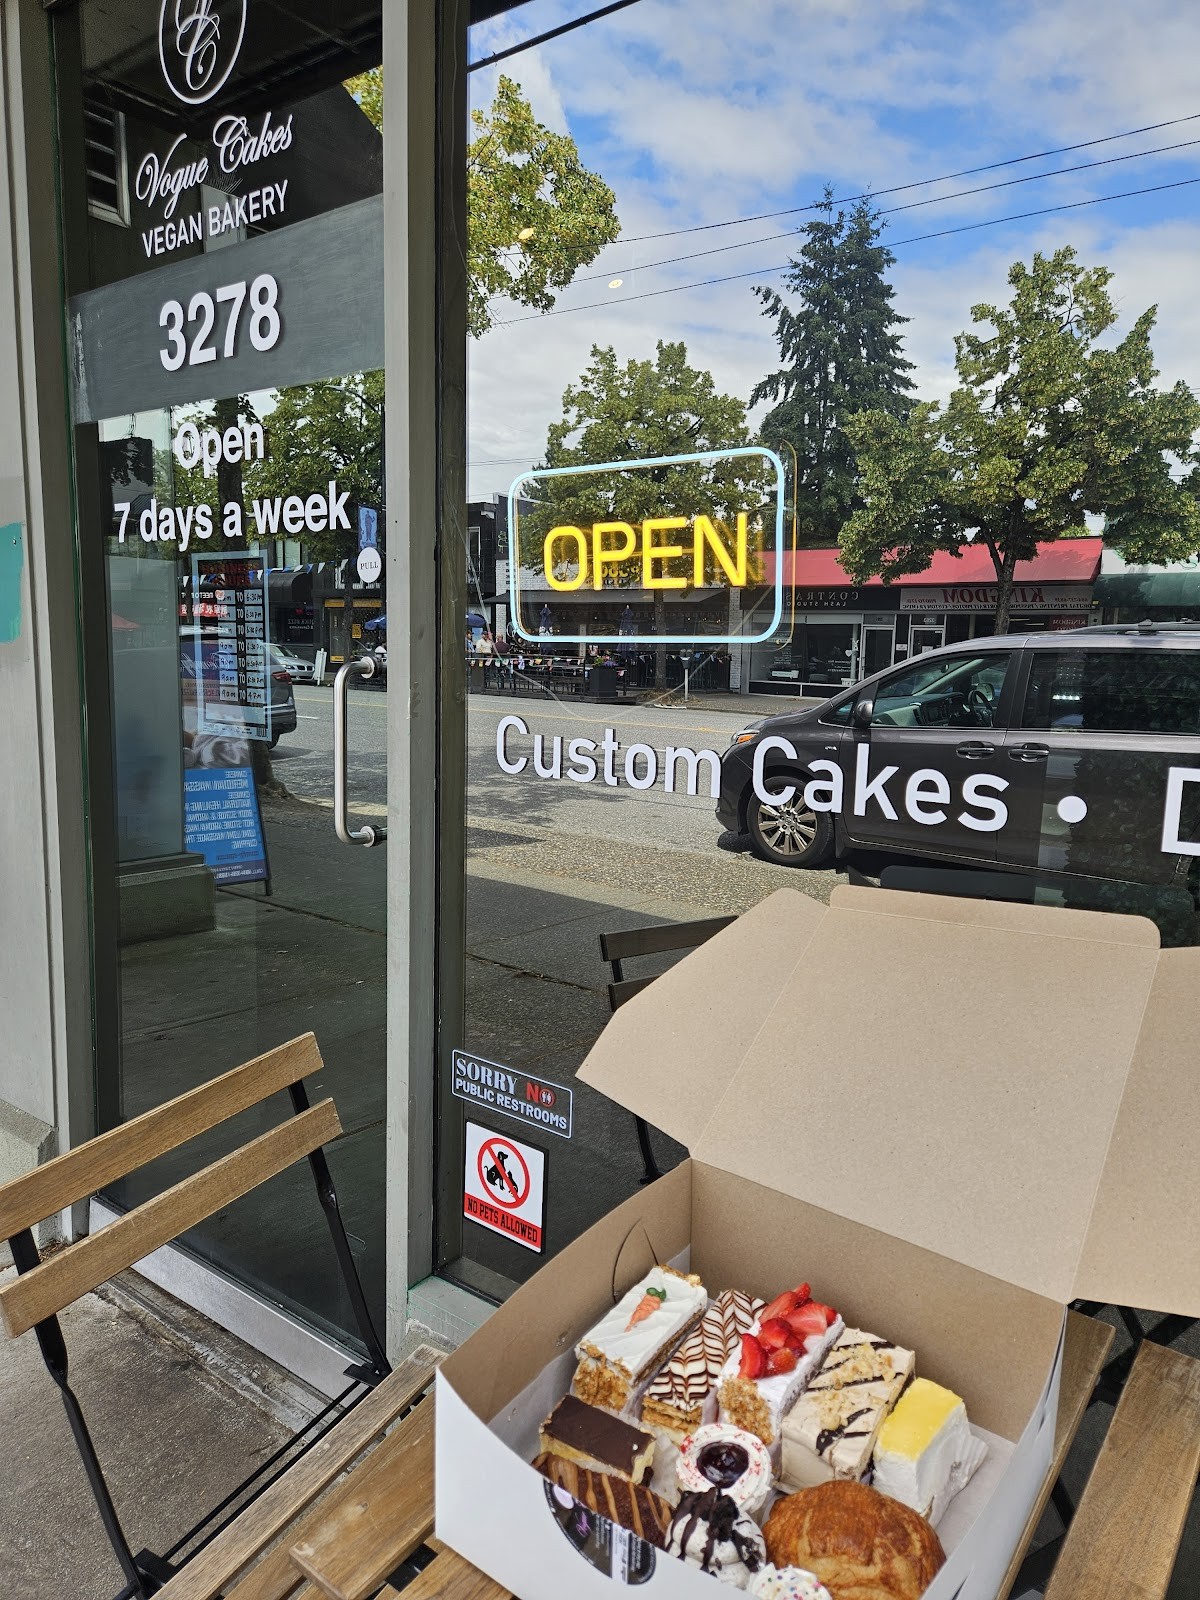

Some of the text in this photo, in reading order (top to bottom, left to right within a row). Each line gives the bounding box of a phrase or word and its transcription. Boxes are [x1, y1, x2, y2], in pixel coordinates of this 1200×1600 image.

[136, 111, 293, 219] Vogue Cakes
[142, 180, 289, 258] VEGAN BAKERY
[159, 274, 281, 372] 3278
[176, 422, 265, 478] Open
[114, 481, 352, 552] 7 days a week
[360, 562, 379, 570] PULL
[544, 512, 748, 592] OPEN
[236, 592, 244, 602] TO
[237, 608, 244, 618] TO
[237, 625, 245, 635] TO
[238, 641, 245, 651] TO
[238, 658, 245, 667] TO
[239, 673, 246, 684] TO
[239, 689, 246, 700] TO
[496, 715, 722, 799] Custom
[752, 735, 1010, 832] Cakes
[455, 1078, 567, 1130] PUBLIC RESTROOMS
[456, 1058, 555, 1108] SORRY NO
[467, 1197, 538, 1243] NO PETS ALLOWED
